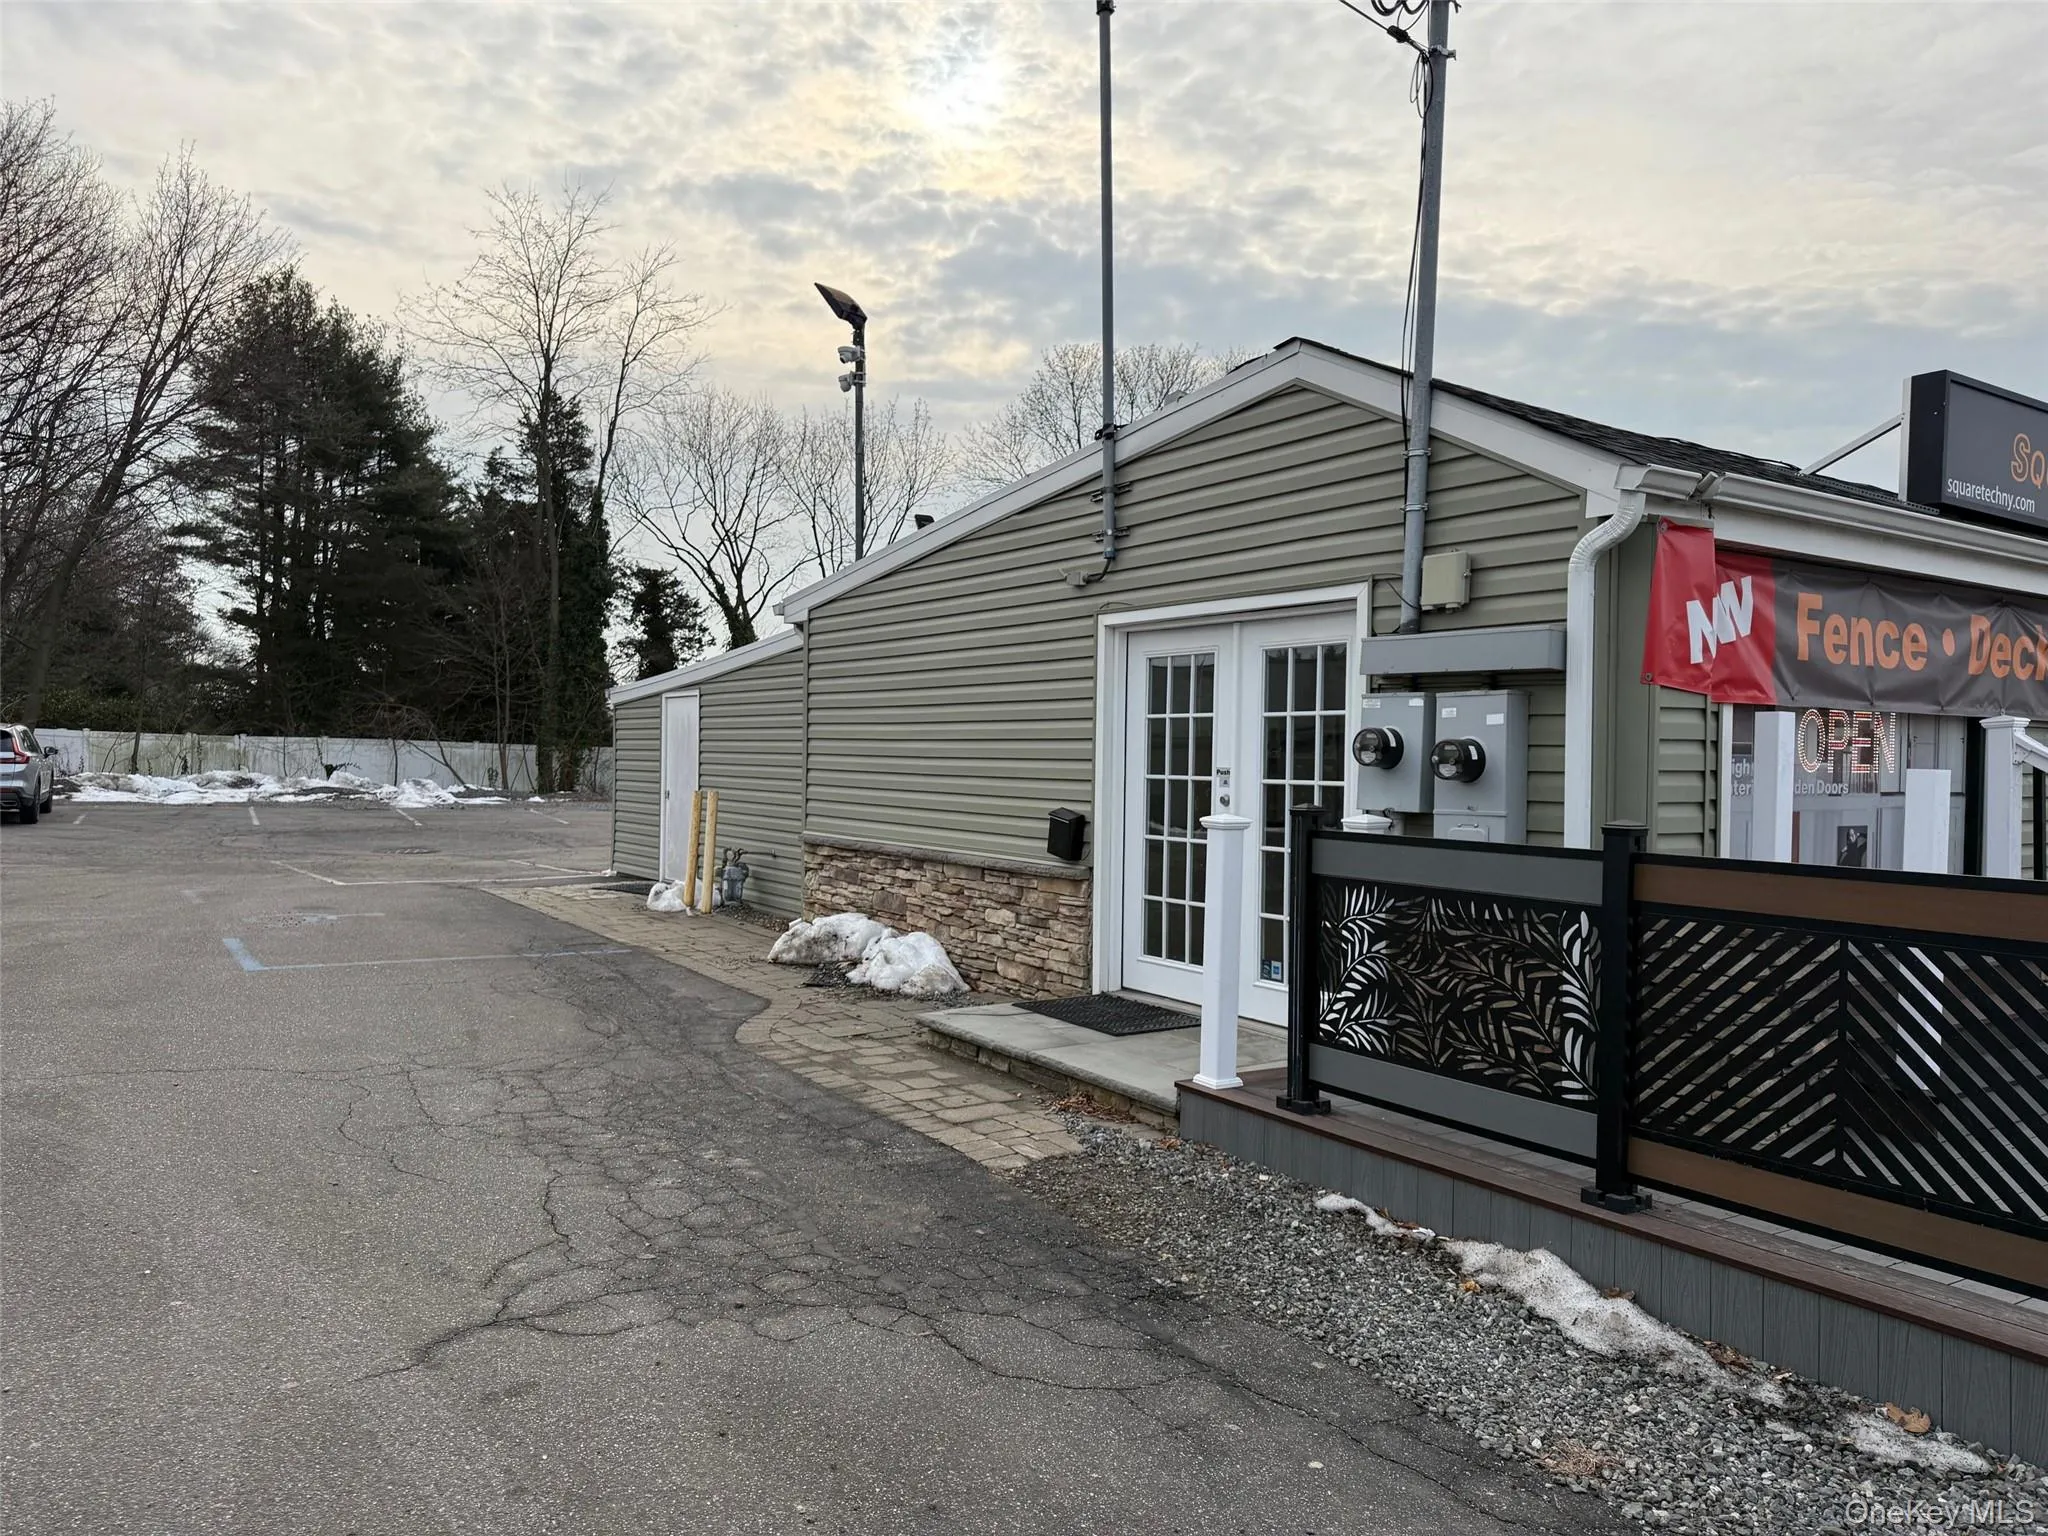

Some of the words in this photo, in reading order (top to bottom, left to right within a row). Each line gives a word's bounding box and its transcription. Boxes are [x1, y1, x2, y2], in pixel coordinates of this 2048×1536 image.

[2010, 432, 2048, 489] SQ
[1947, 478, 2036, 513] squaretechny.com
[1796, 591, 1929, 672] Fence
[1797, 708, 1897, 774] OPEN
[1216, 768, 1231, 776] Push
[1816, 779, 1850, 795] Doors
